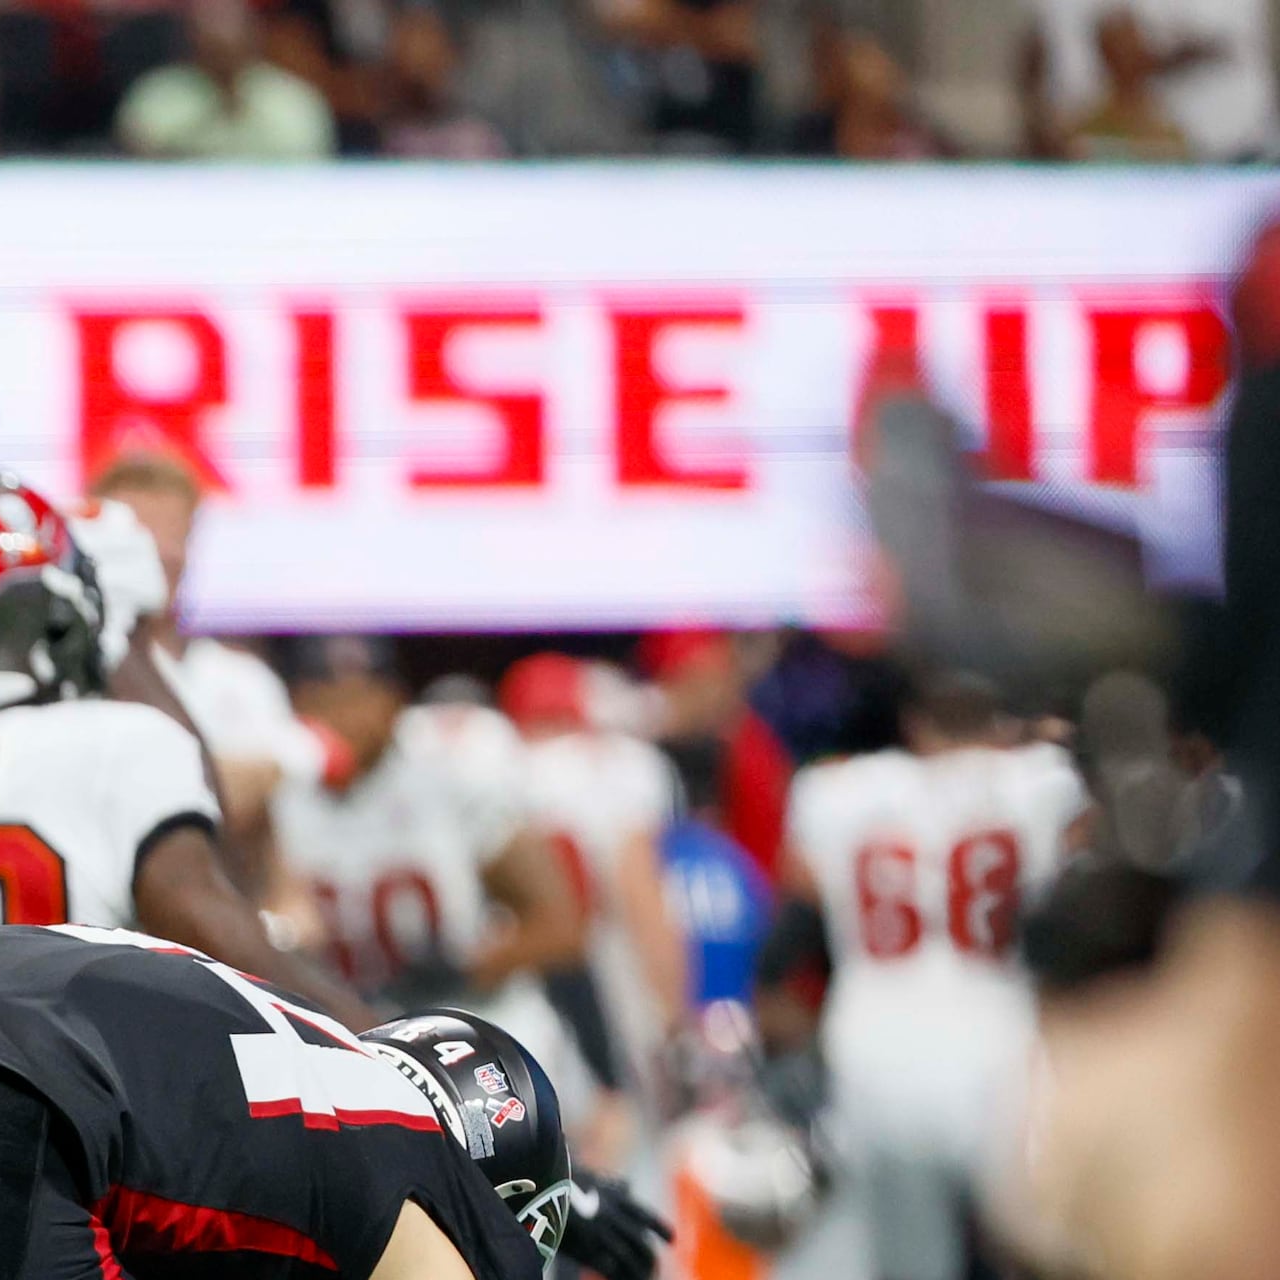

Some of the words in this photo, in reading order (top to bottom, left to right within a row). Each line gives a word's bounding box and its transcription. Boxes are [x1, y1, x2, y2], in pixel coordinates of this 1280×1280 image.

[70, 300, 750, 491] RISE
[852, 300, 1232, 491] UP
[855, 828, 1020, 964] 68
